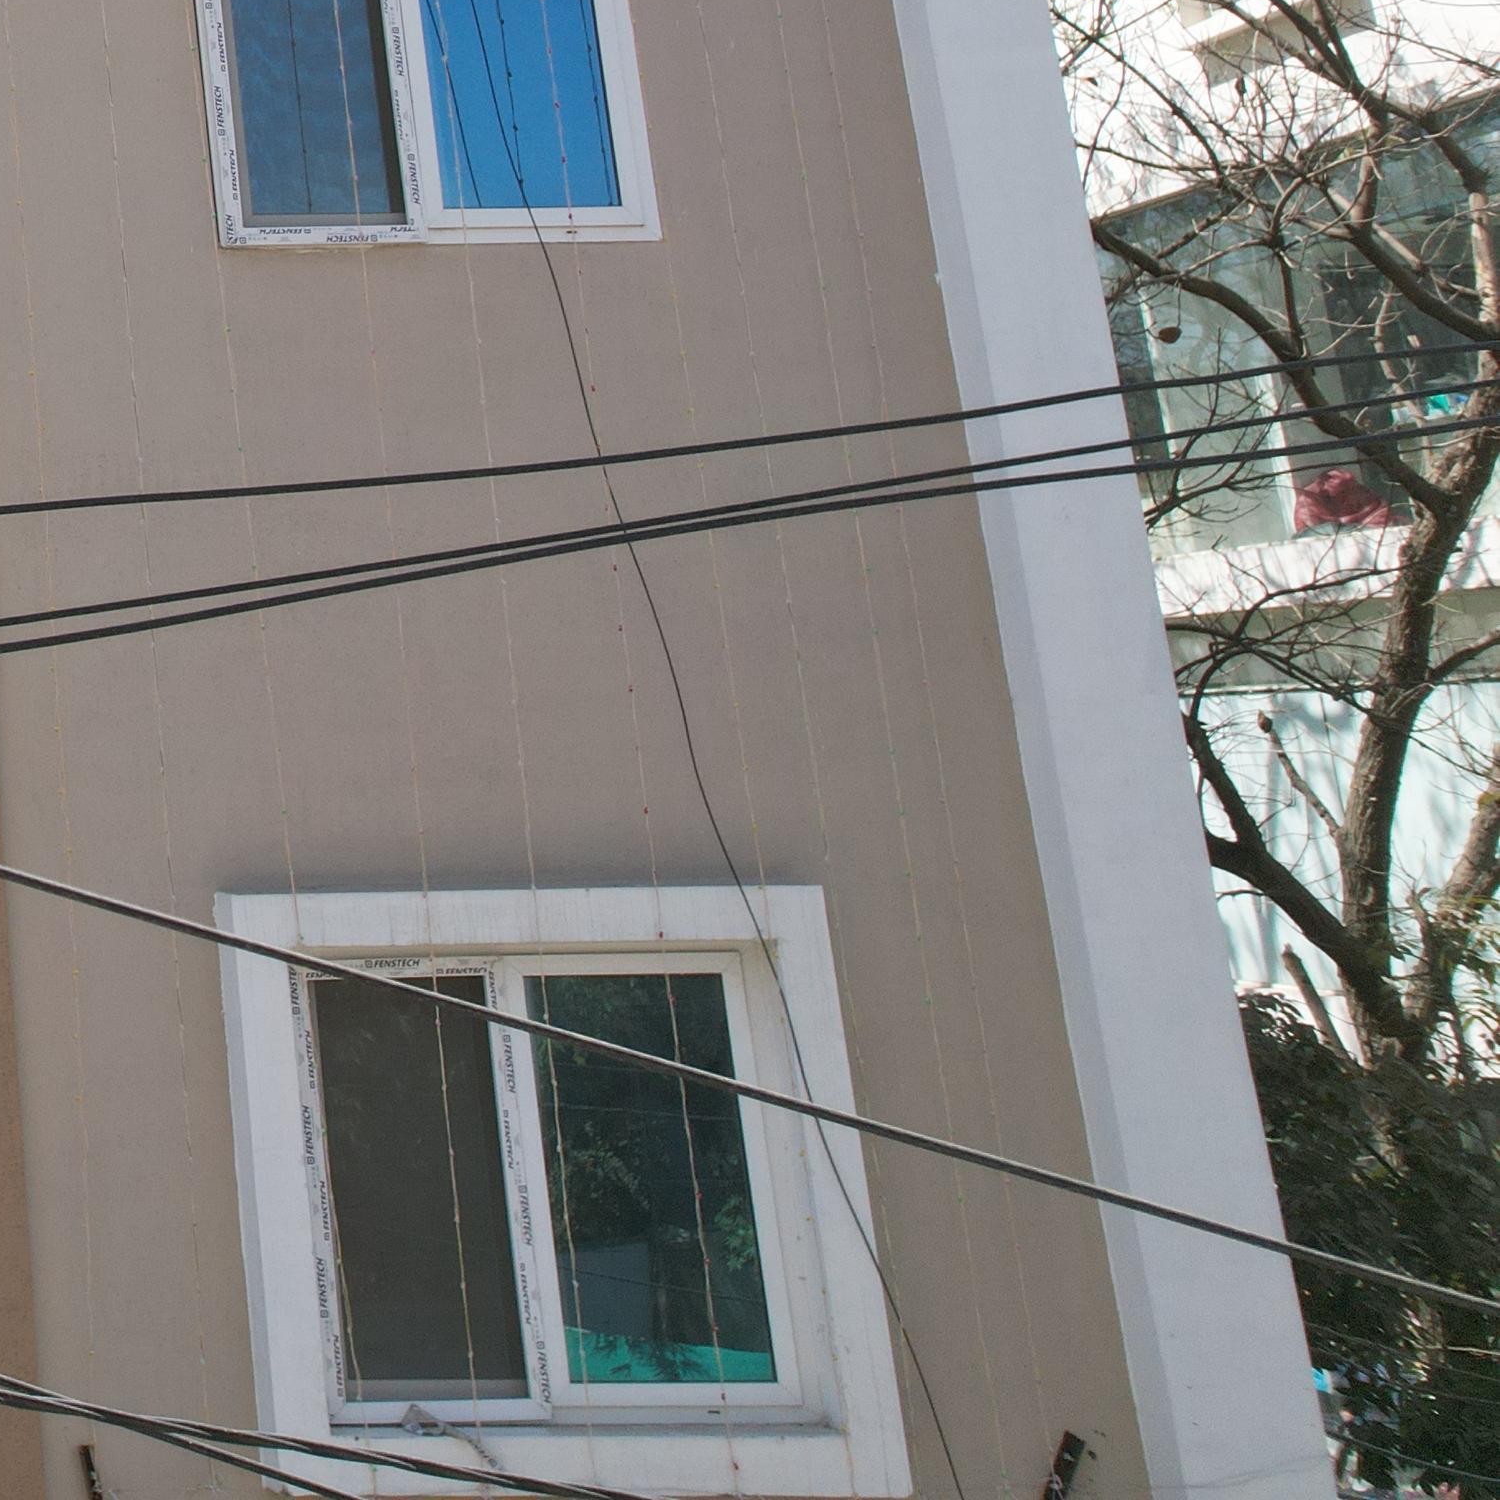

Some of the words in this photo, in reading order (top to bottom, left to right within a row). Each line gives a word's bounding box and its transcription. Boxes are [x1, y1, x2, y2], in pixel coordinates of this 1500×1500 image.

[213, 85, 225, 128] FENSTECH
[374, 958, 420, 968] FENSTECH
[503, 1043, 517, 1094] FENSTECH
[301, 1104, 315, 1155] FENSTECH
[520, 1194, 533, 1247] FENSTECH
[315, 1256, 328, 1309] FENSTECH
[537, 1351, 552, 1404] FENSTECH
